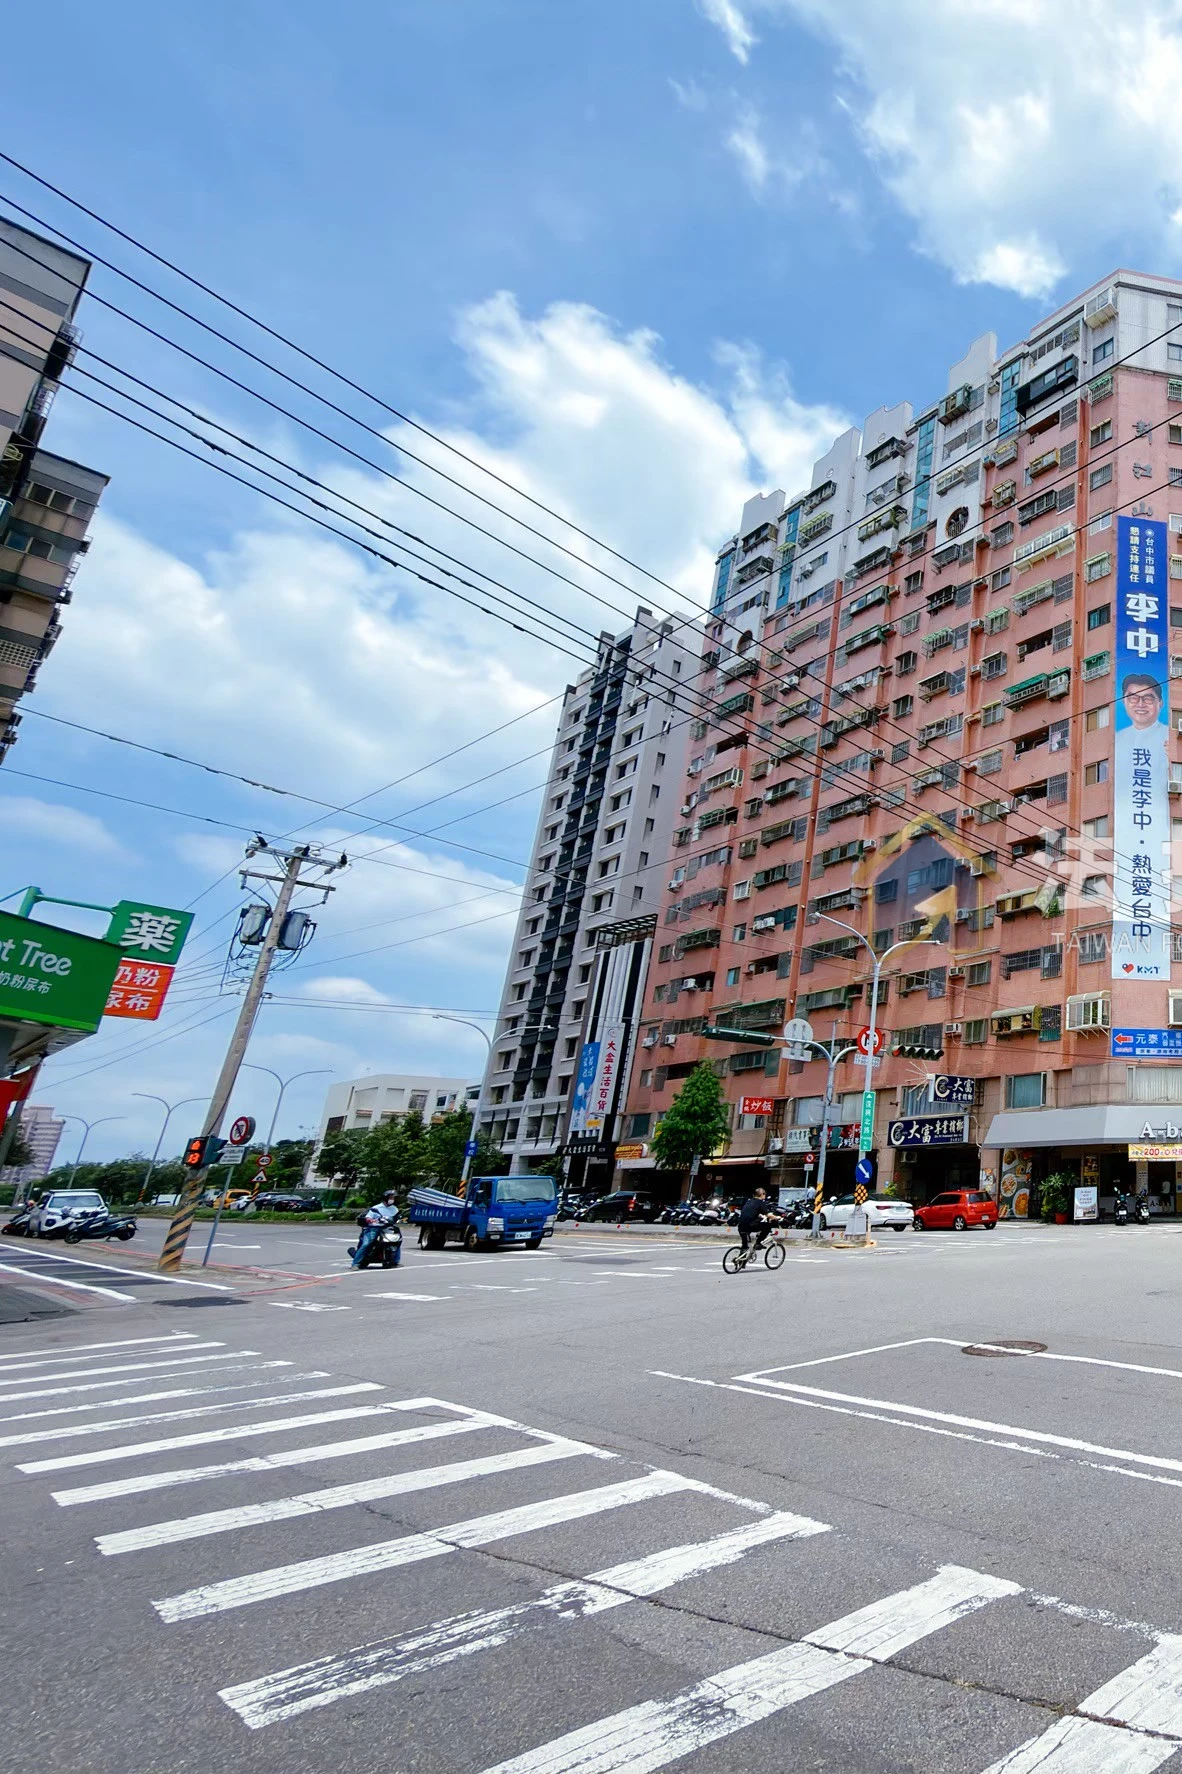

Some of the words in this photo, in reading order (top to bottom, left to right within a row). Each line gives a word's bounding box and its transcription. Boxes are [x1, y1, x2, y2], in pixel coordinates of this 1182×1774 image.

[1129, 526, 1140, 583] 懇請支持連任
[1145, 537, 1155, 584] 台中市議員
[1126, 592, 1159, 658] 李中
[22, 939, 73, 976] Tree
[1136, 1033, 1158, 1044] 元泰
[952, 1078, 974, 1093] 大富
[750, 1100, 773, 1112] 炒飯
[908, 1120, 933, 1143] 大富
